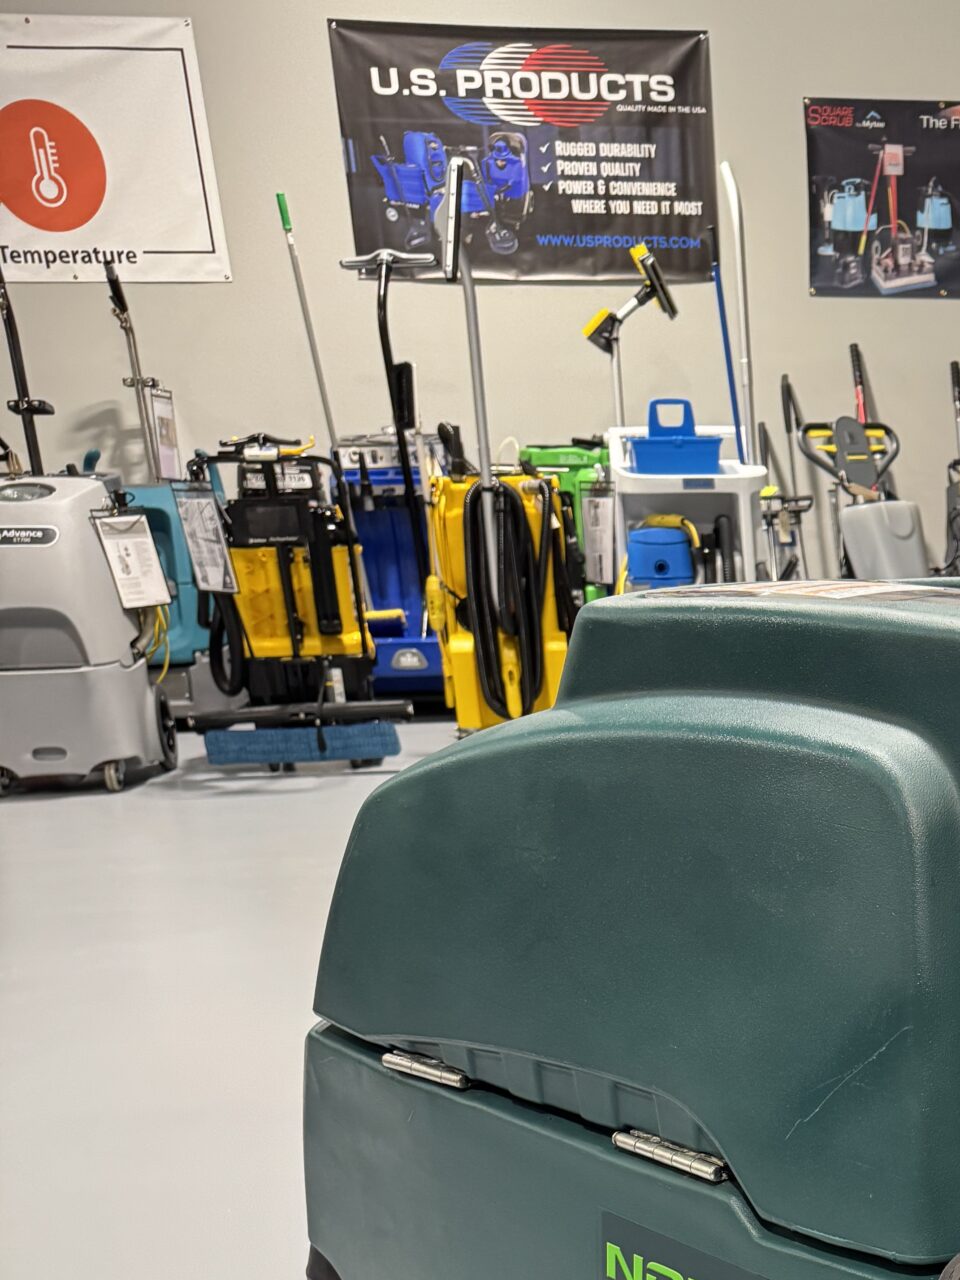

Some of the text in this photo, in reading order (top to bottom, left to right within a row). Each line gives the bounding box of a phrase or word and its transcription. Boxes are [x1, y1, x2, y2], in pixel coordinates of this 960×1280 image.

[370, 67, 675, 102] U.S. PRODUCTS
[616, 104, 646, 113] QUALITY
[647, 105, 667, 113] MADE
[677, 106, 690, 114] THE
[692, 106, 707, 114] USA
[919, 115, 948, 129] The
[555, 141, 656, 158] RUGGED DURABILITY
[556, 160, 641, 177] PROVEN QUALITY
[558, 179, 677, 196] POWER & CONVENIENCE
[571, 199, 704, 216] WHERE YOU NEED IT MOST
[0, 245, 138, 269] Temperature
[2, 529, 43, 538] Advance
